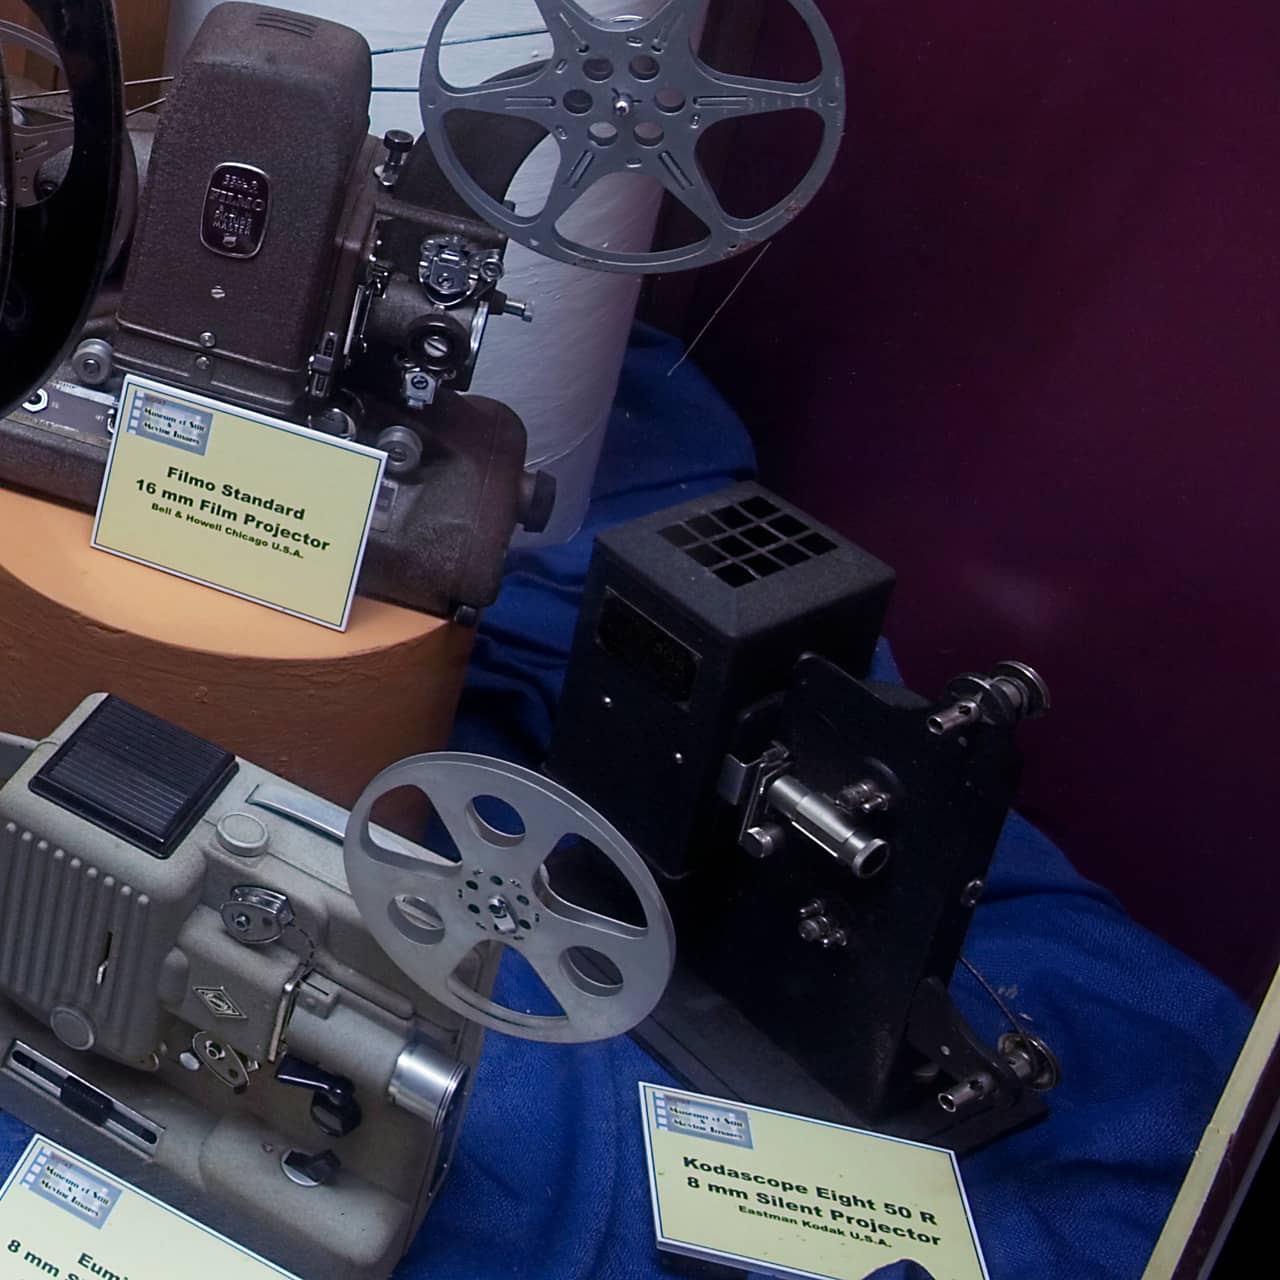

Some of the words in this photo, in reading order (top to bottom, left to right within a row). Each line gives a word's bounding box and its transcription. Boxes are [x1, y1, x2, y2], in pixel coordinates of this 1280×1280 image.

[136, 480, 156, 494] 16
[162, 488, 193, 507] mm
[200, 499, 238, 521] Film
[244, 513, 330, 550] Projector
[167, 466, 215, 492] Filmo
[221, 484, 305, 520] Standard
[152, 502, 172, 514] Bell
[175, 510, 182, 518] &
[186, 512, 222, 532] Howell
[225, 527, 268, 548] Chicago
[272, 542, 304, 559] U.S.A.
[683, 1156, 808, 1195] Kodascope
[816, 1186, 876, 1211] Eight
[884, 1203, 910, 1219] 50
[920, 1211, 937, 1225] R
[688, 1177, 700, 1189] 8
[708, 1181, 749, 1200] mm
[756, 1192, 822, 1218] Silent
[830, 1210, 941, 1246] Projector
[739, 1205, 798, 1225] Eastman
[803, 1219, 846, 1237] Kodak
[851, 1231, 893, 1248] U.S.A.
[7, 1239, 21, 1253] 8
[24, 1251, 60, 1277] mm
